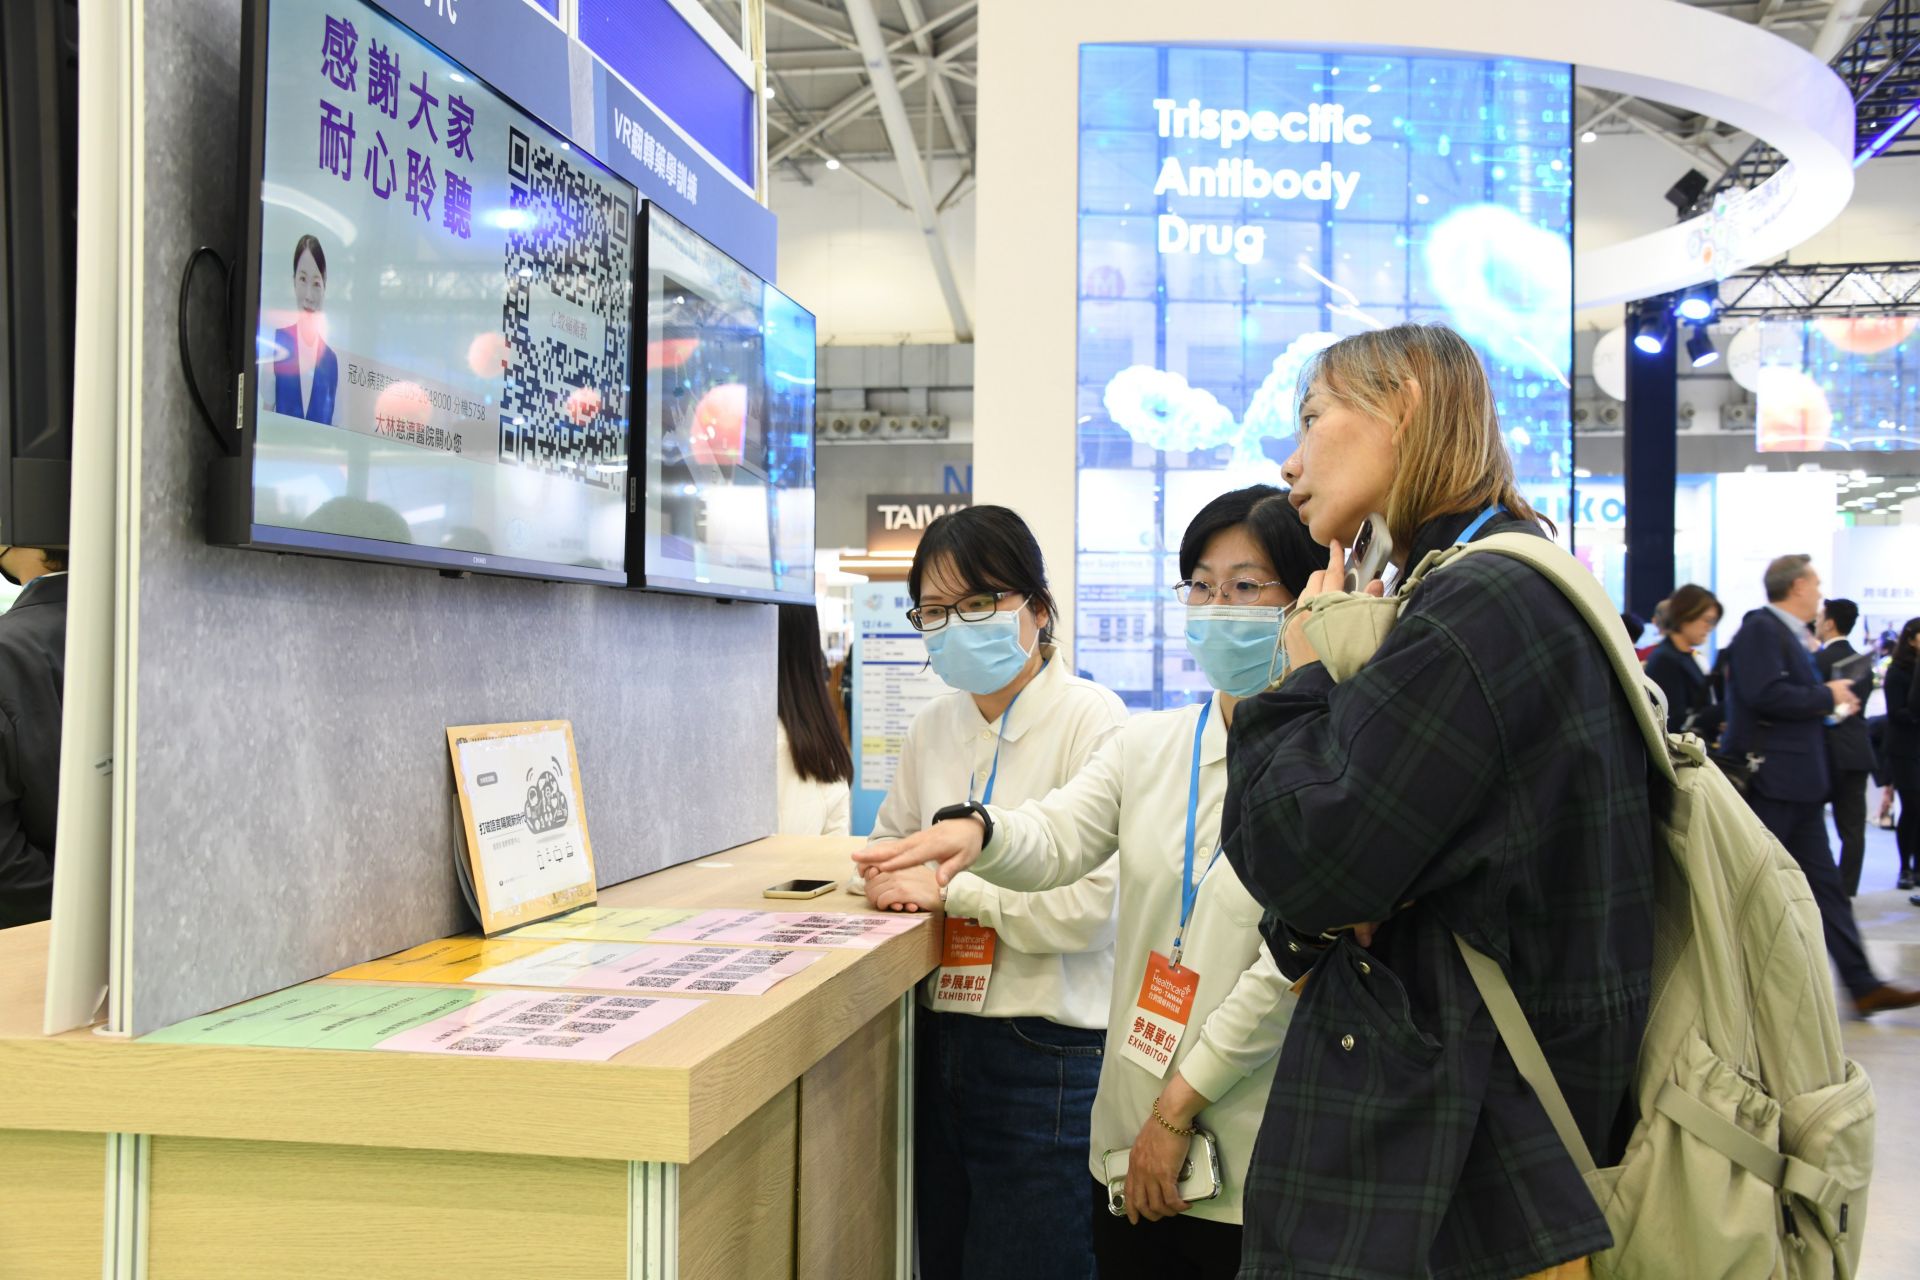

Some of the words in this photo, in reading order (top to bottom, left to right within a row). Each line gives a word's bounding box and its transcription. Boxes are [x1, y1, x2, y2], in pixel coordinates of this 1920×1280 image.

[320, 14, 475, 163] 感謝大家
[1152, 98, 1372, 149] Trispecific
[319, 98, 473, 240] 耐心聆聽
[1153, 156, 1361, 210] Antibody
[1158, 214, 1266, 265] Drug
[375, 413, 463, 454] 大林慈濟醫院關心您
[937, 991, 982, 1002] EXHIBITOR
[940, 974, 986, 991] 參展單位
[1127, 1035, 1169, 1065] EXHIBITOR
[1133, 1016, 1177, 1053] 參展單位
